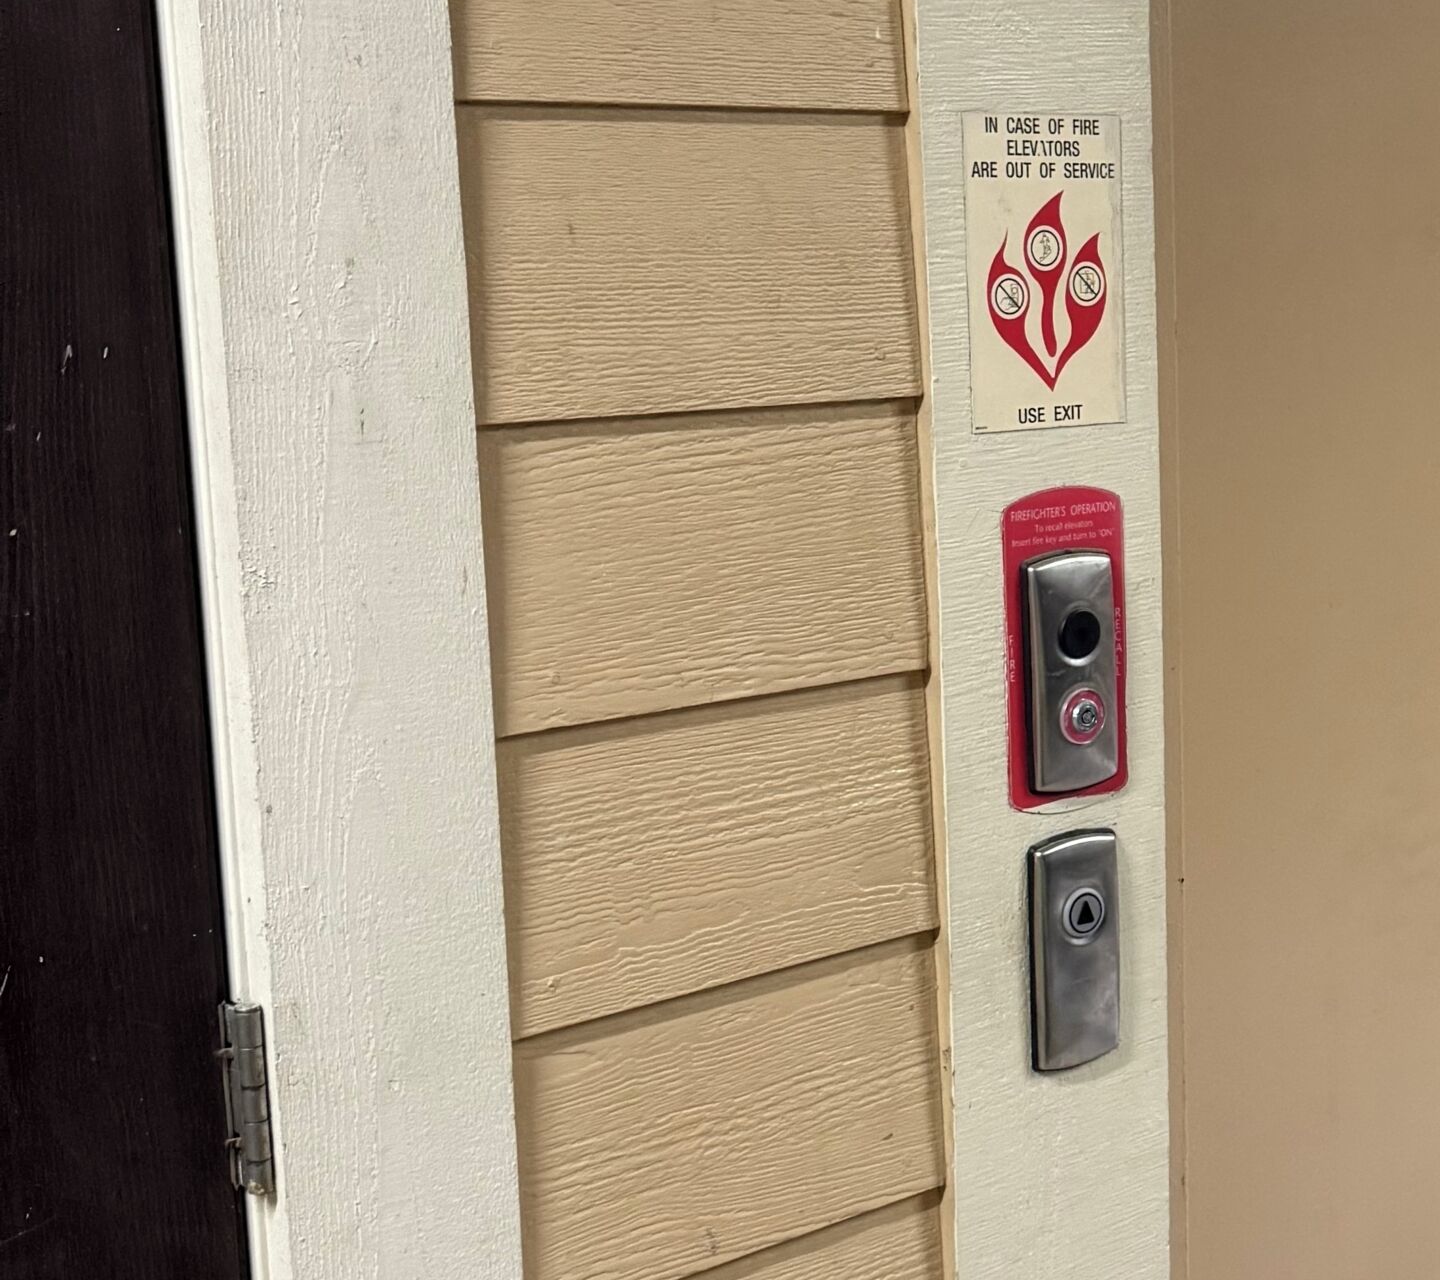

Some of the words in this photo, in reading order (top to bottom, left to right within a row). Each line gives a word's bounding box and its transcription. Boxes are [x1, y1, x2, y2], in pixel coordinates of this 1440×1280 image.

[985, 117, 998, 133] IN
[1006, 117, 1041, 134] CASE
[1048, 118, 1065, 135] OF
[1072, 119, 1100, 135] FIRE
[971, 161, 998, 178] ARE
[1006, 162, 1032, 178] OUT
[1039, 162, 1056, 179] OF
[1063, 163, 1116, 179] SERVICE
[1018, 407, 1046, 424] USE
[1054, 404, 1083, 421] EXIT
[1010, 506, 1066, 522] FIREFIGHTER'S
[1070, 500, 1116, 516] OPERATION
[1034, 524, 1044, 533] To
[1045, 522, 1062, 532] recall
[1064, 520, 1094, 530] elevators
[1045, 536, 1057, 546] key
[1058, 533, 1072, 542] and
[1089, 530, 1096, 539] to
[1114, 607, 1123, 677] RECALL
[1008, 634, 1016, 683] FIRE
